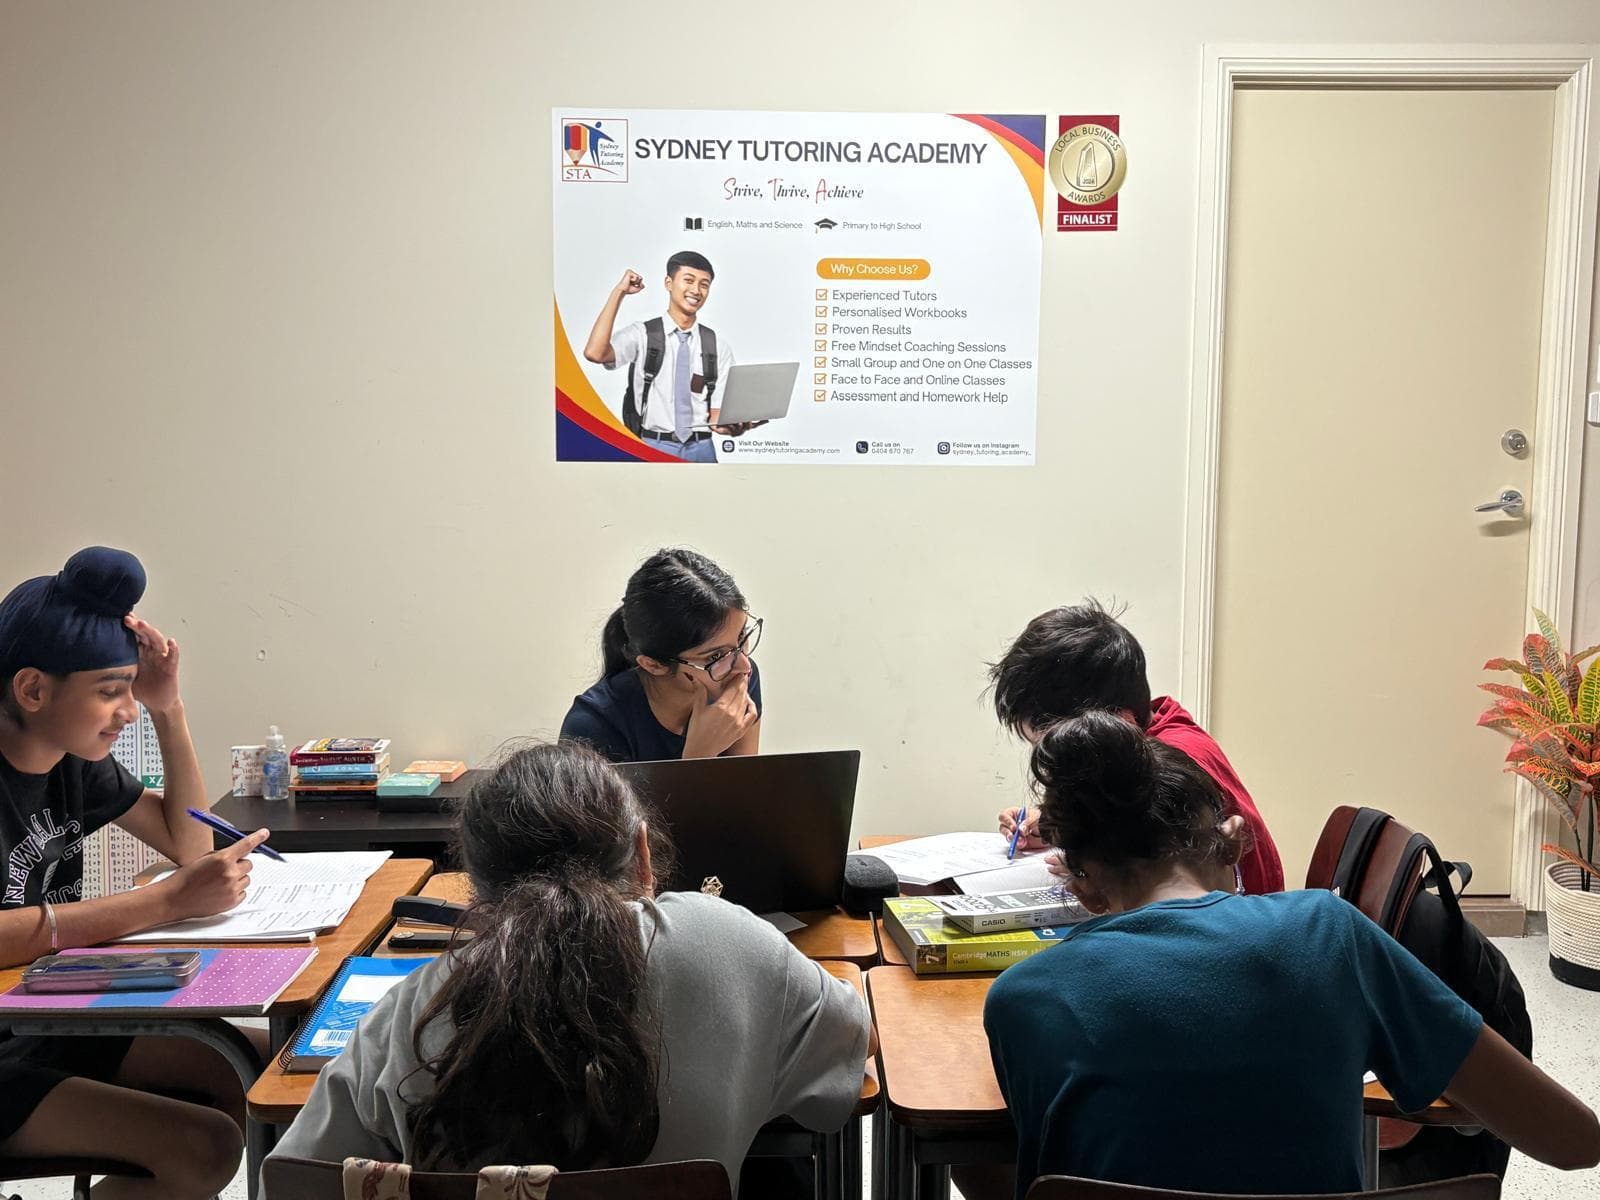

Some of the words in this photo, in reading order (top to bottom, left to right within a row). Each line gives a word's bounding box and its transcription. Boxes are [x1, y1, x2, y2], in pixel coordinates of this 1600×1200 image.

[1055, 130, 1080, 153] LOCAL
[1082, 126, 1121, 151] BUSINESS
[635, 138, 732, 160] SYDNEY
[738, 140, 861, 163] TUTORING
[867, 141, 987, 164] ACADEMY
[566, 168, 592, 180] STA
[723, 177, 763, 200] Strive,
[768, 178, 809, 201] Thrive,
[815, 178, 864, 204] Achieve
[1067, 190, 1106, 204] AWARDS
[707, 219, 734, 230] English,
[736, 220, 754, 228] Maths
[754, 221, 772, 229] and
[774, 221, 803, 229] Science
[1062, 214, 1113, 225] FINALIST
[842, 221, 868, 231] Primary
[870, 222, 878, 230] to
[880, 222, 895, 232] High
[897, 221, 922, 230] School
[830, 262, 855, 276] Why
[856, 263, 896, 275] Choose
[898, 263, 919, 276] Us?
[832, 290, 900, 302] Experienced
[902, 291, 937, 301] Tutors
[832, 306, 902, 317] Personalised
[904, 307, 967, 319] Workbooks
[832, 323, 869, 334] Proven
[872, 324, 911, 335] Results
[831, 340, 856, 351] Free
[858, 341, 901, 352] Mindset
[904, 341, 954, 354] Coaching
[957, 342, 1006, 353] Sessions
[831, 357, 861, 368] Small
[863, 358, 897, 371] Group
[900, 358, 919, 369] and
[922, 358, 945, 369] One
[947, 360, 961, 369] on
[963, 358, 987, 369] One
[988, 358, 1033, 370] Classes
[831, 374, 857, 385] Face
[860, 374, 872, 385] to
[874, 374, 900, 385] Face
[903, 374, 923, 385] and
[926, 374, 960, 386] Online
[962, 375, 1006, 386] Classes
[831, 390, 897, 402] Assessment
[900, 391, 919, 402] and
[922, 391, 980, 403] Homework
[983, 391, 1008, 405] Help
[764, 440, 790, 448] Website
[990, 442, 1020, 450] Instagram
[738, 447, 841, 455] www.sydneytutoringacademy.com
[981, 918, 1006, 927] CASIO
